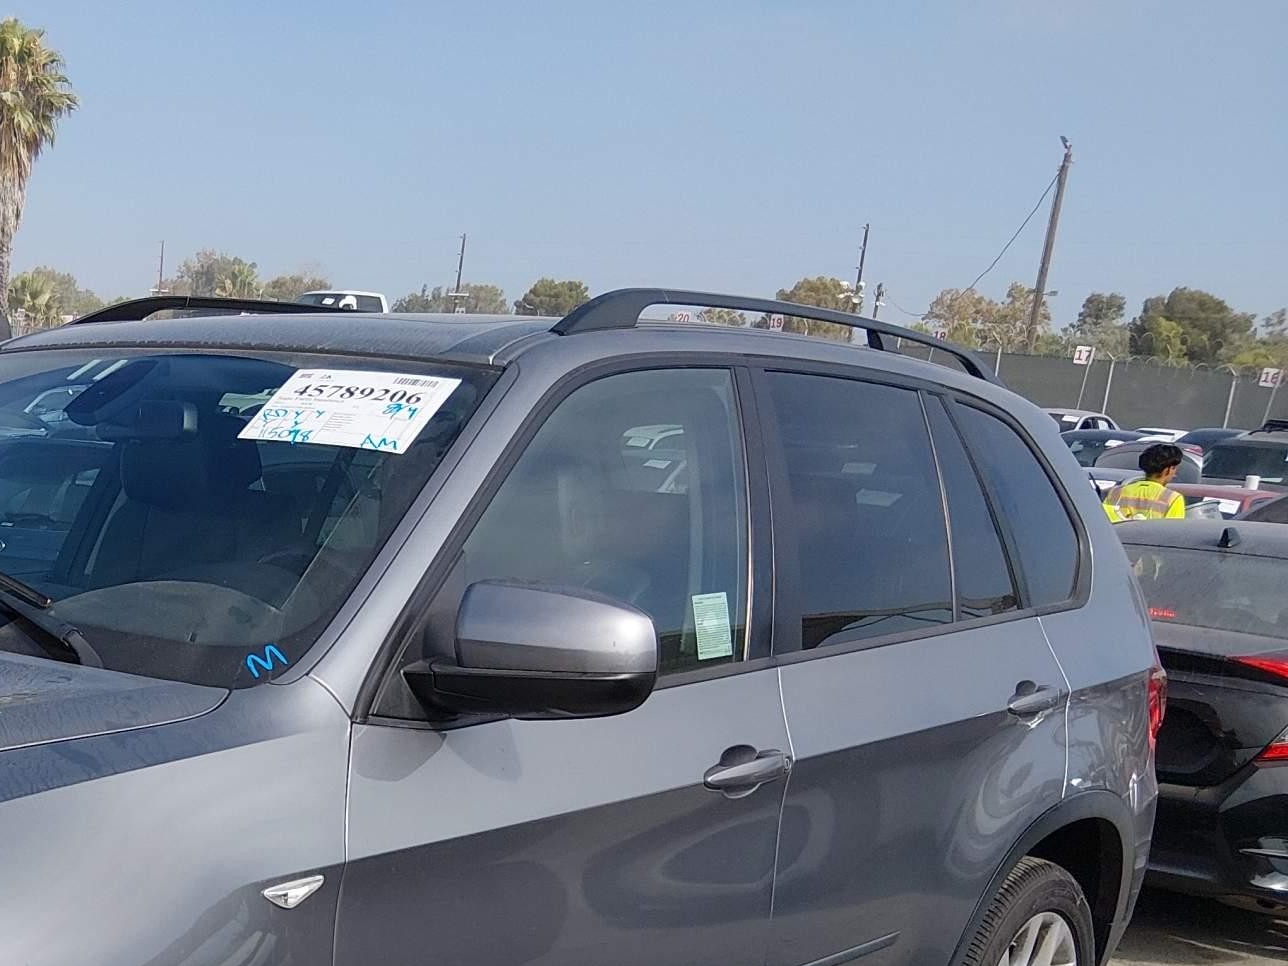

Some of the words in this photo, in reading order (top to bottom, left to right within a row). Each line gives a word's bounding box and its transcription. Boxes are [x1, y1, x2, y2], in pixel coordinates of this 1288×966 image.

[677, 313, 690, 323] 20
[770, 317, 783, 329] 19
[1075, 349, 1092, 362] 17
[1261, 371, 1280, 384] 16
[294, 383, 423, 405] 45789206
[246, 644, 289, 678] M
